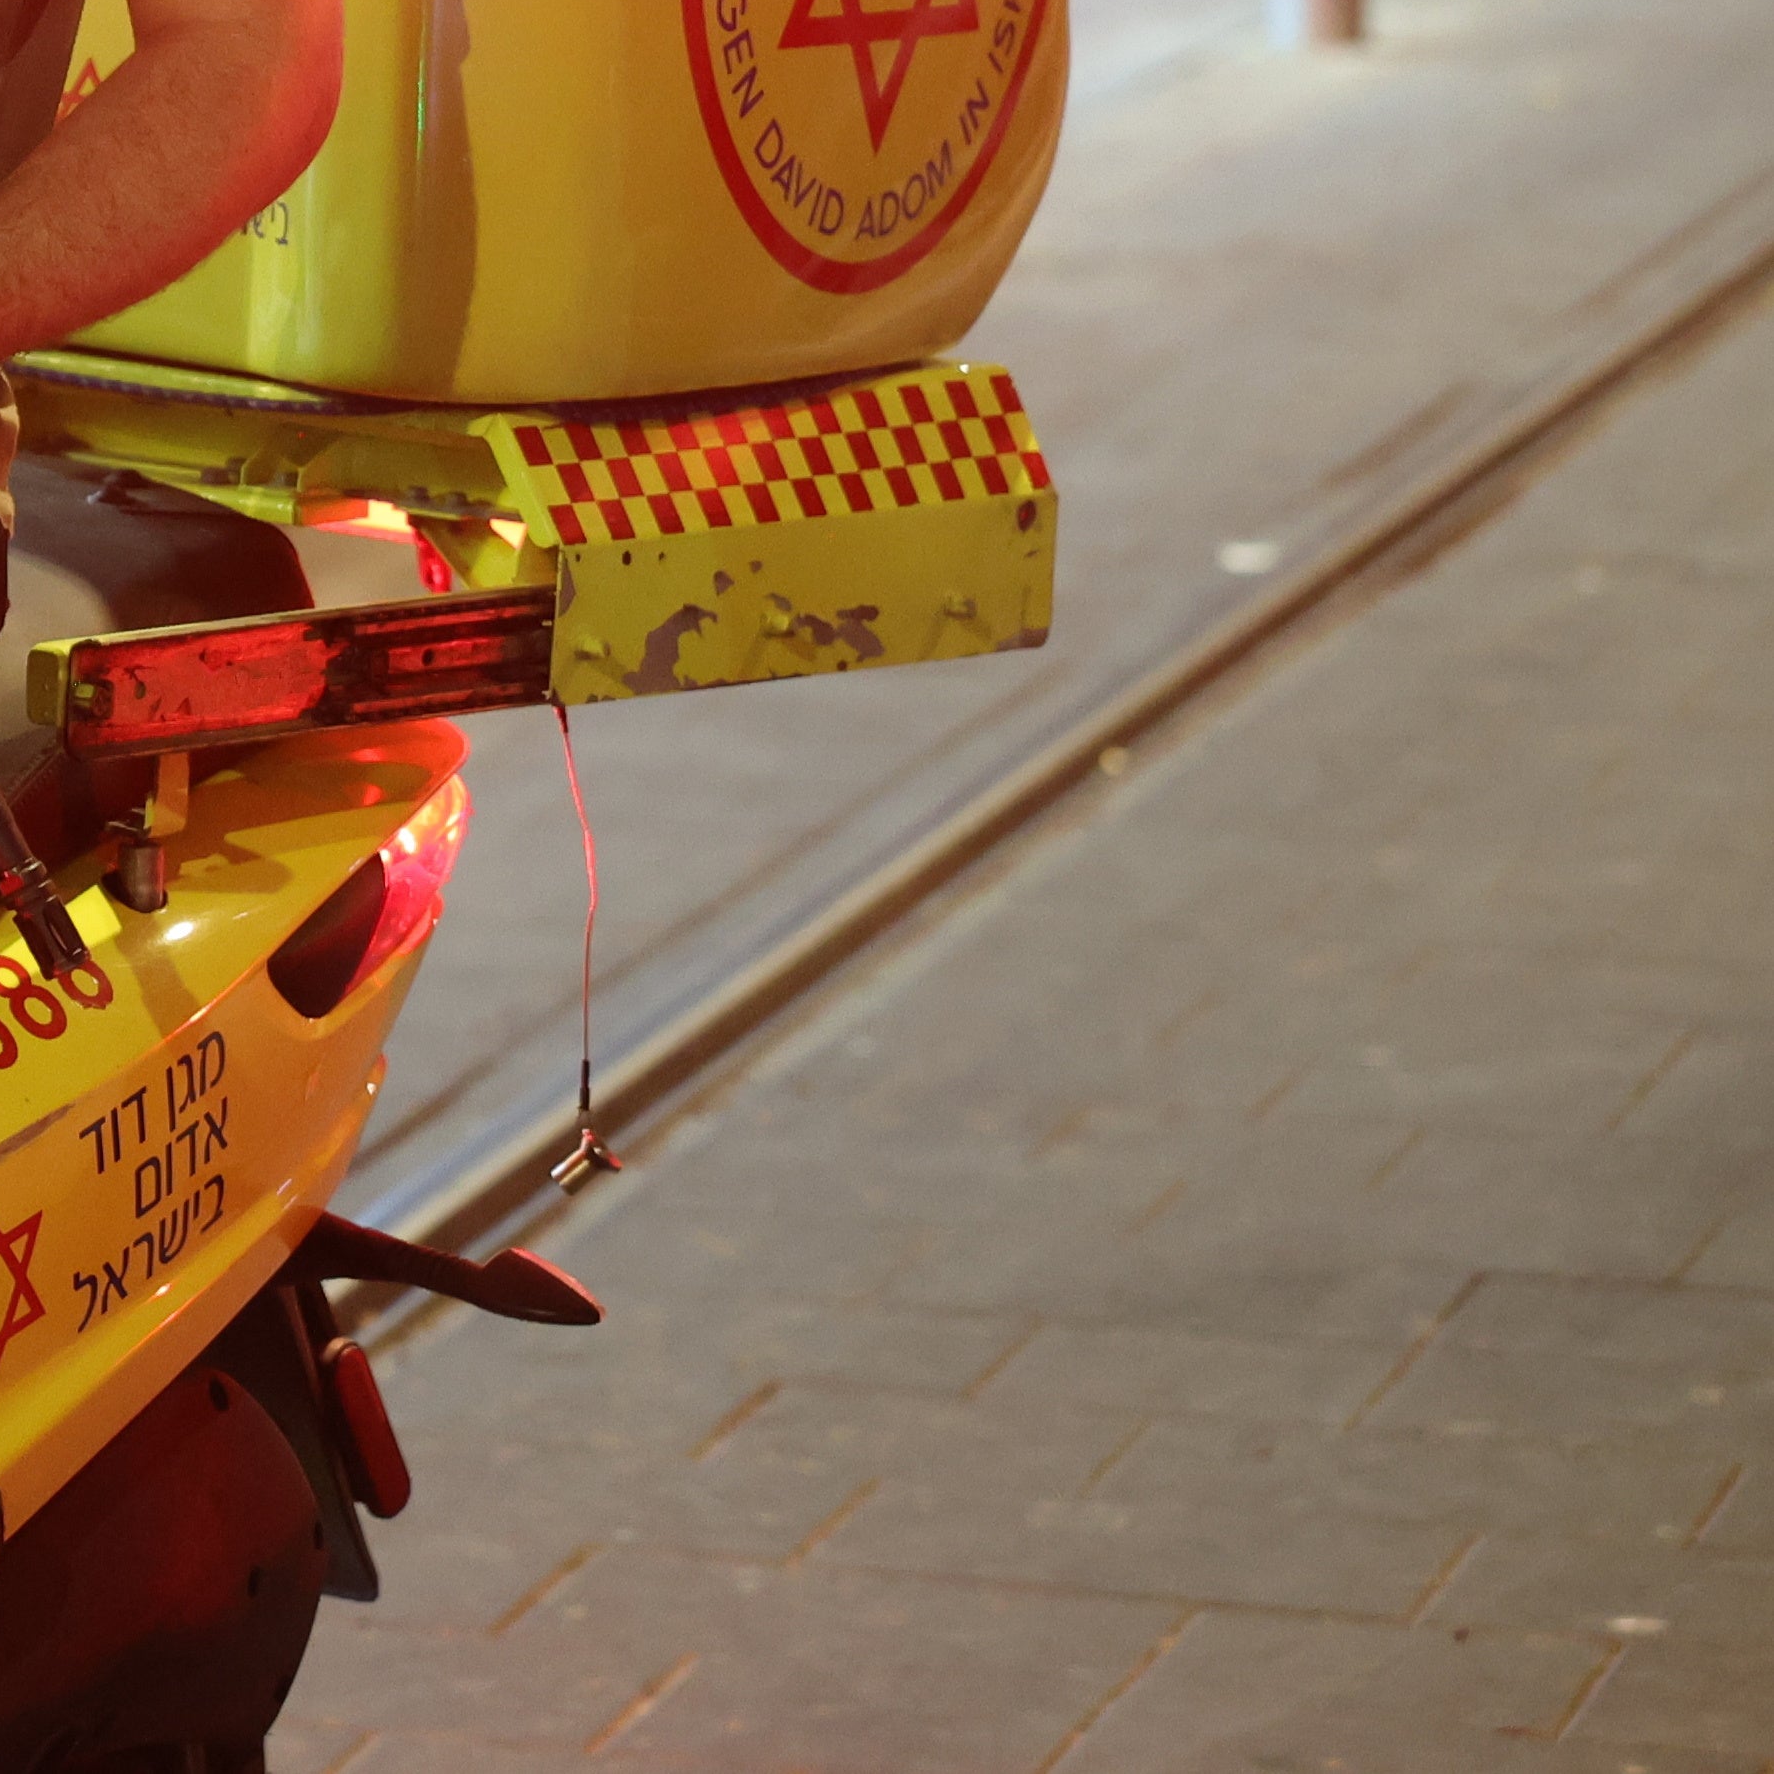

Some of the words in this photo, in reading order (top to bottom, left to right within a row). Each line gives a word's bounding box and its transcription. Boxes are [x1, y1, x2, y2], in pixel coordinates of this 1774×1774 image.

[754, 118, 845, 237] DAVID
[854, 138, 954, 242] ADOM
[959, 78, 991, 147] IN
[79, 1085, 148, 1175] דוד
[164, 1030, 226, 1133] מגן
[134, 1096, 228, 1219] אדום
[73, 1174, 225, 1334] בישראל
